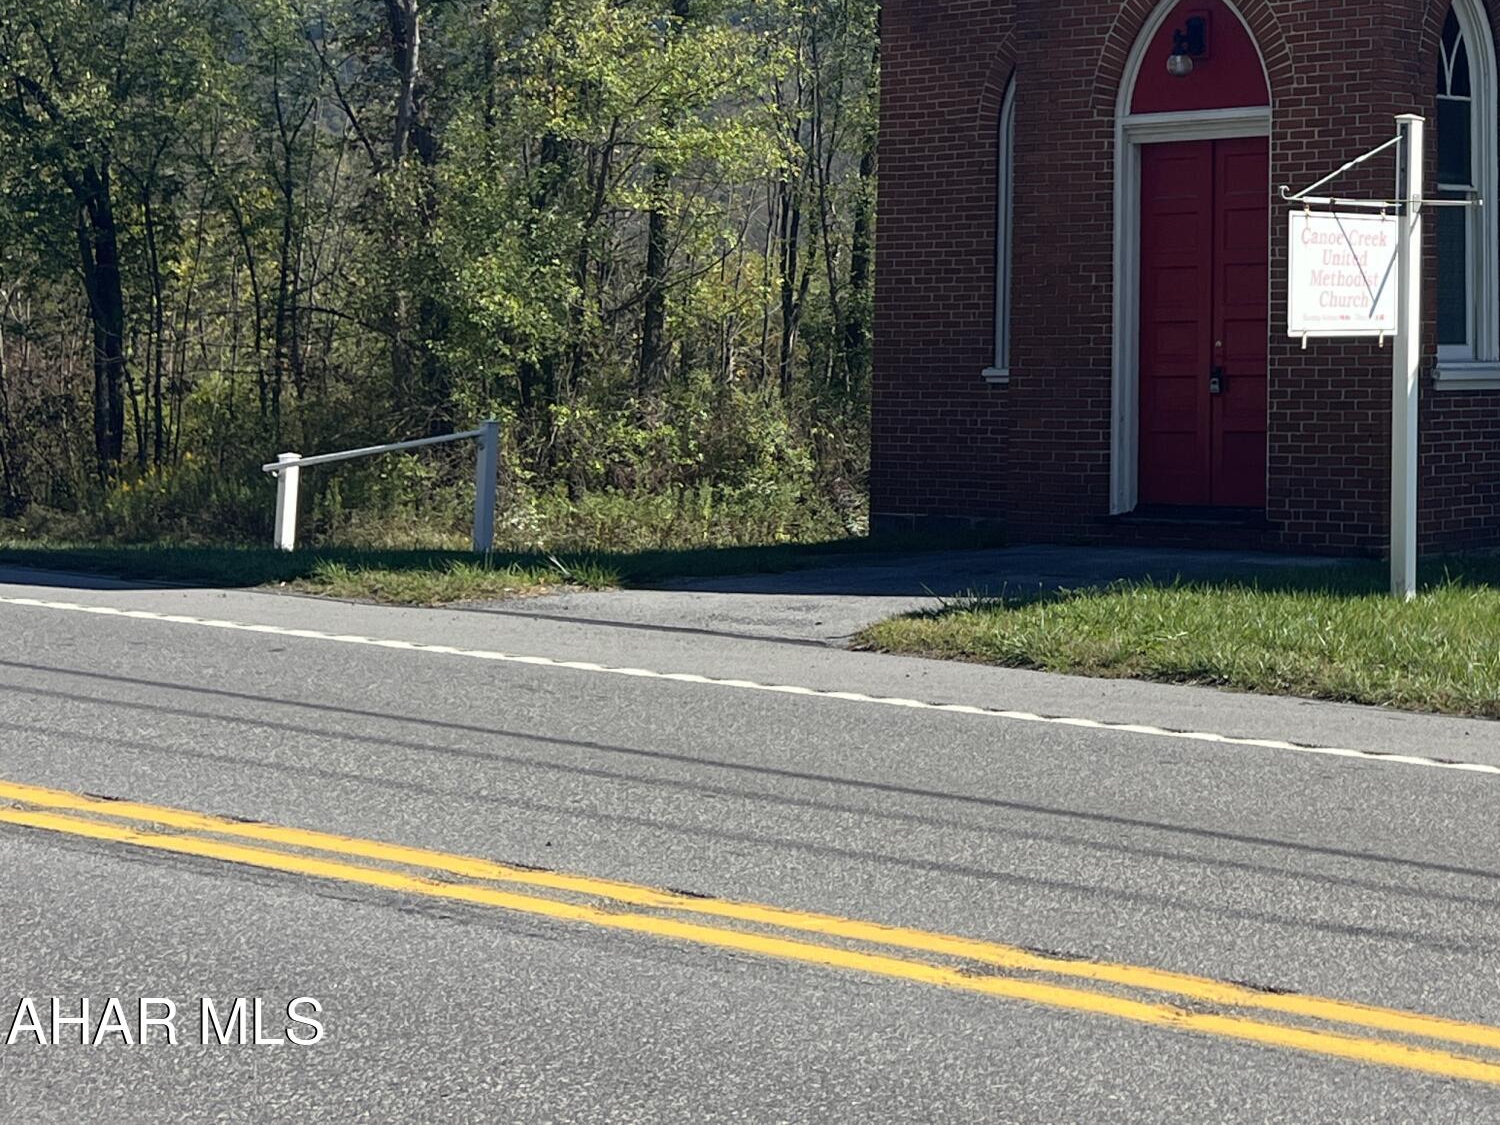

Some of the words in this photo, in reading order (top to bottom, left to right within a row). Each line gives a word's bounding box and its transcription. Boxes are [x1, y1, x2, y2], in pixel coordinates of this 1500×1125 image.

[1301, 227, 1343, 245] Canoe
[1349, 229, 1388, 247] Creek
[1319, 290, 1369, 308] Church
